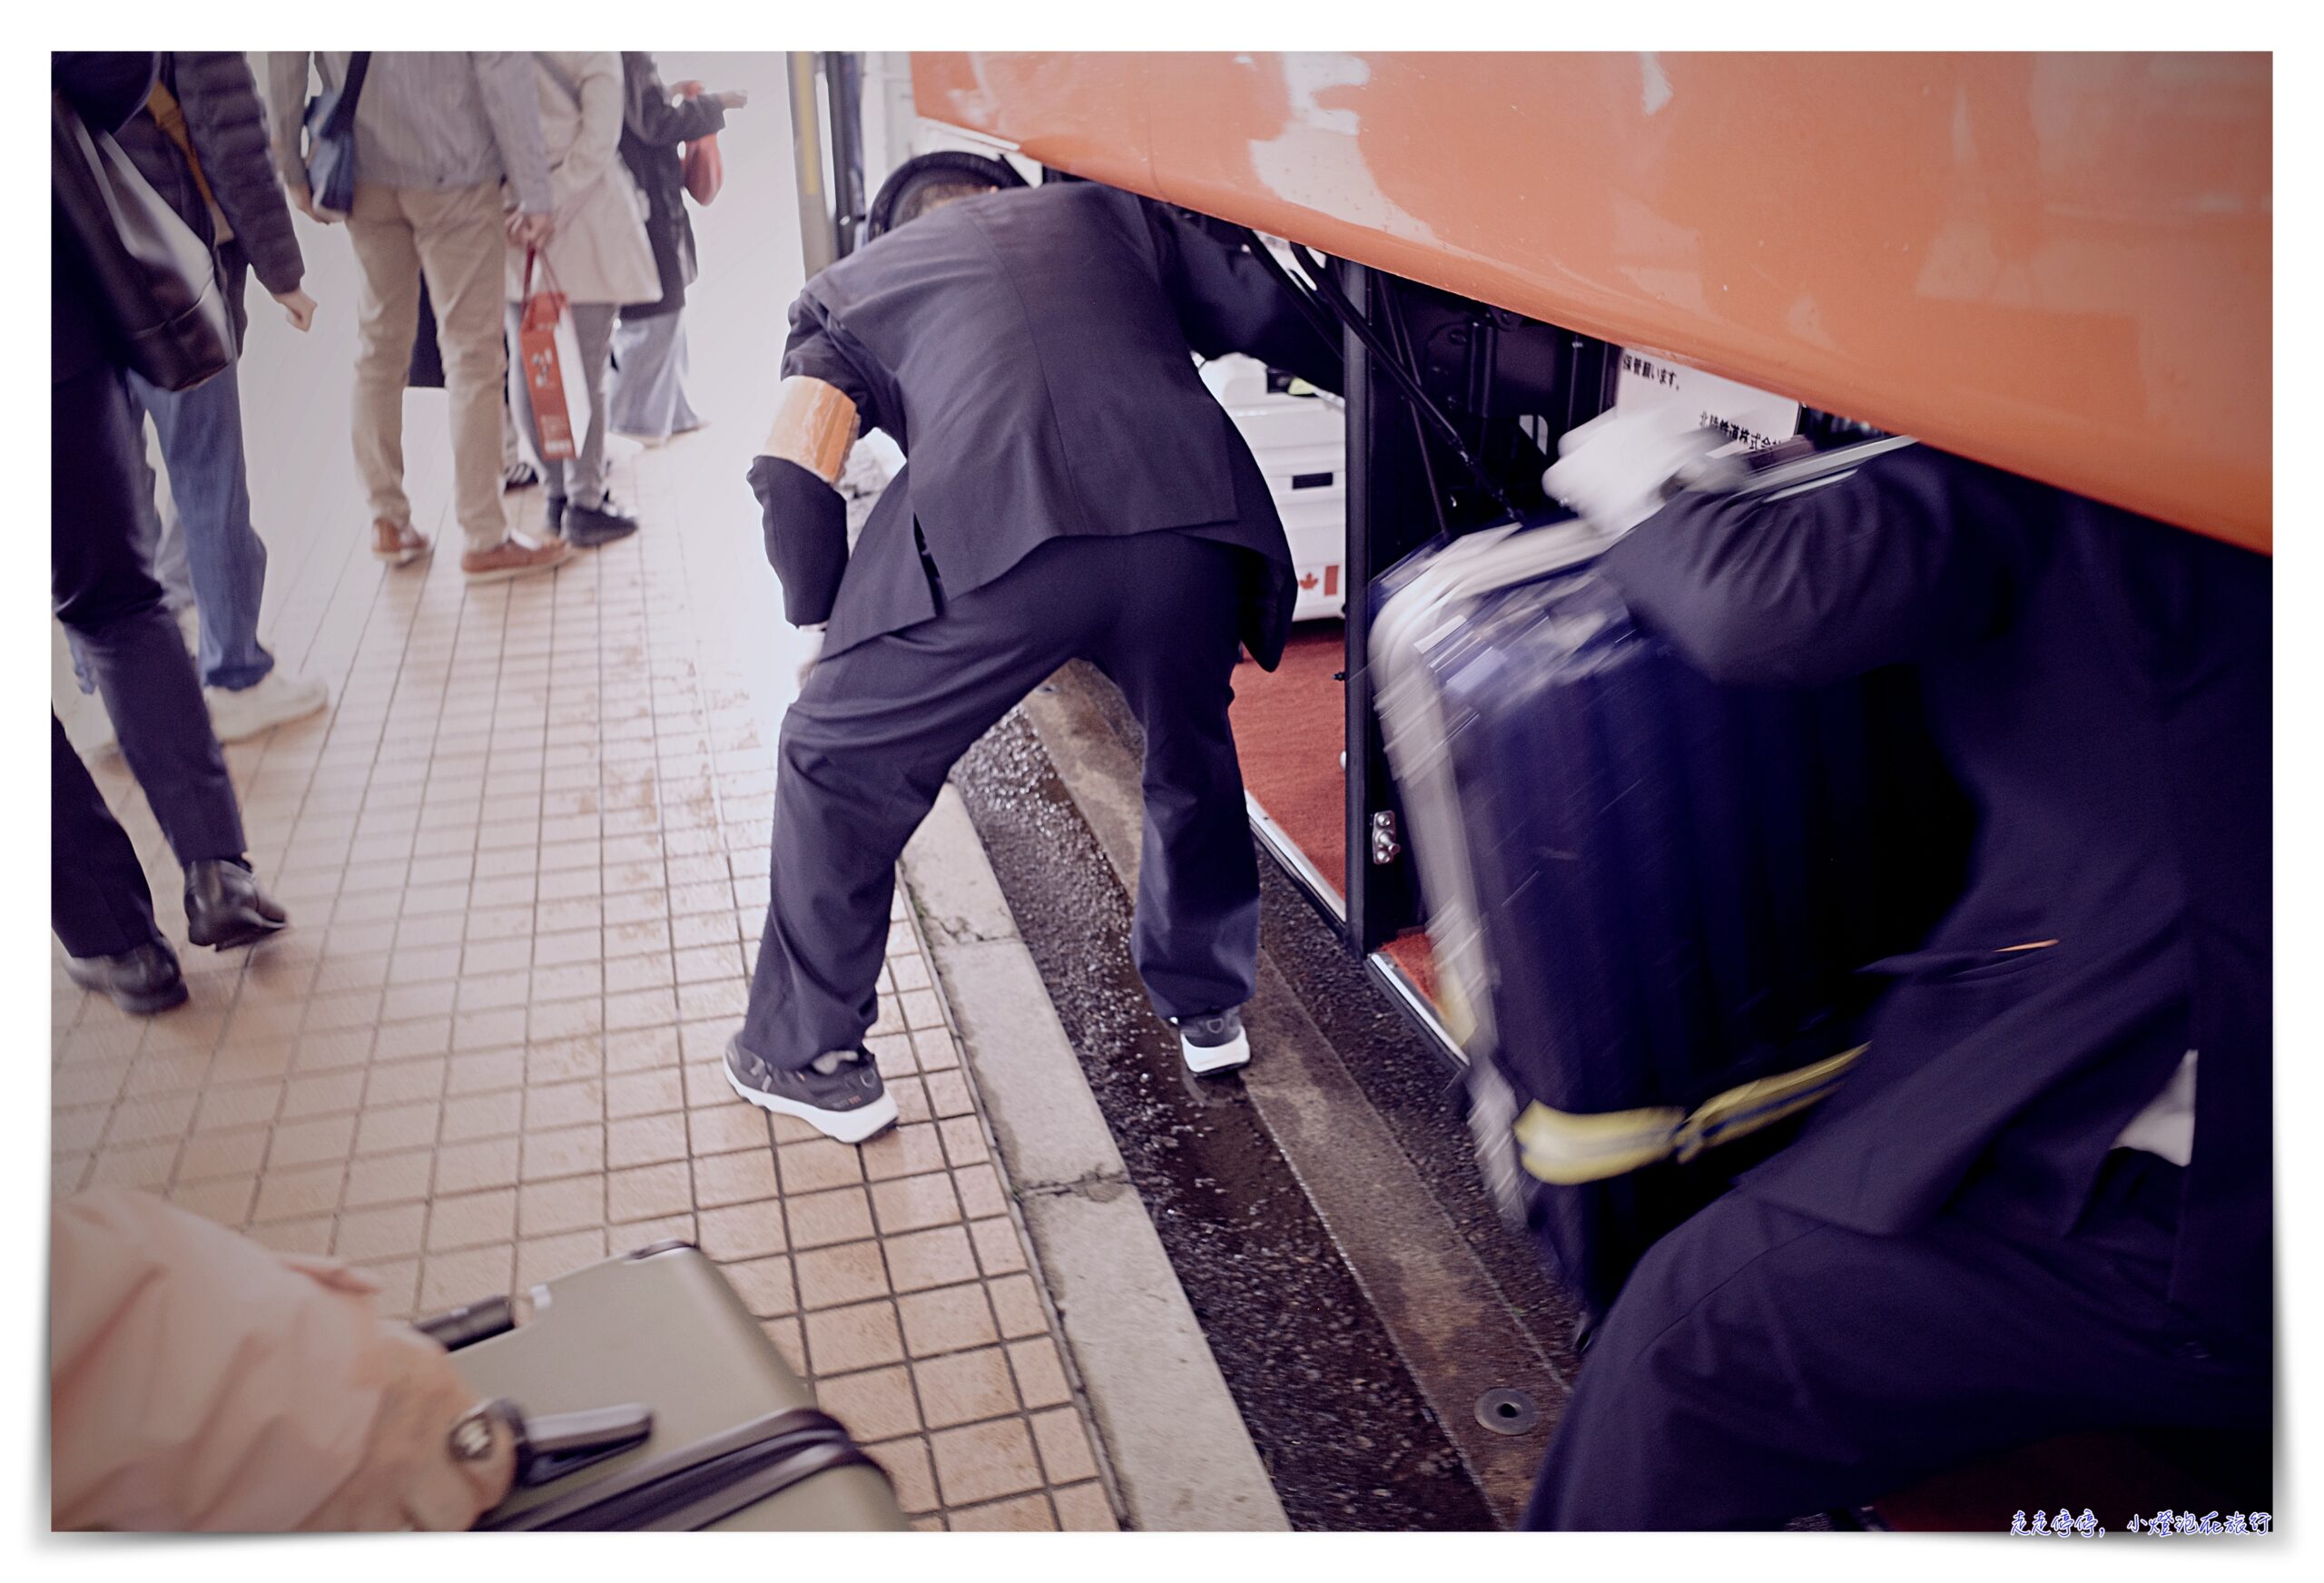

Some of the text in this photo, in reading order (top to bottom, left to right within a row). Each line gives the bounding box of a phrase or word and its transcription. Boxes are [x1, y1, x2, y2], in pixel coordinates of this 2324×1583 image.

[1699, 411, 1781, 450] 北陸鉄道株式会
